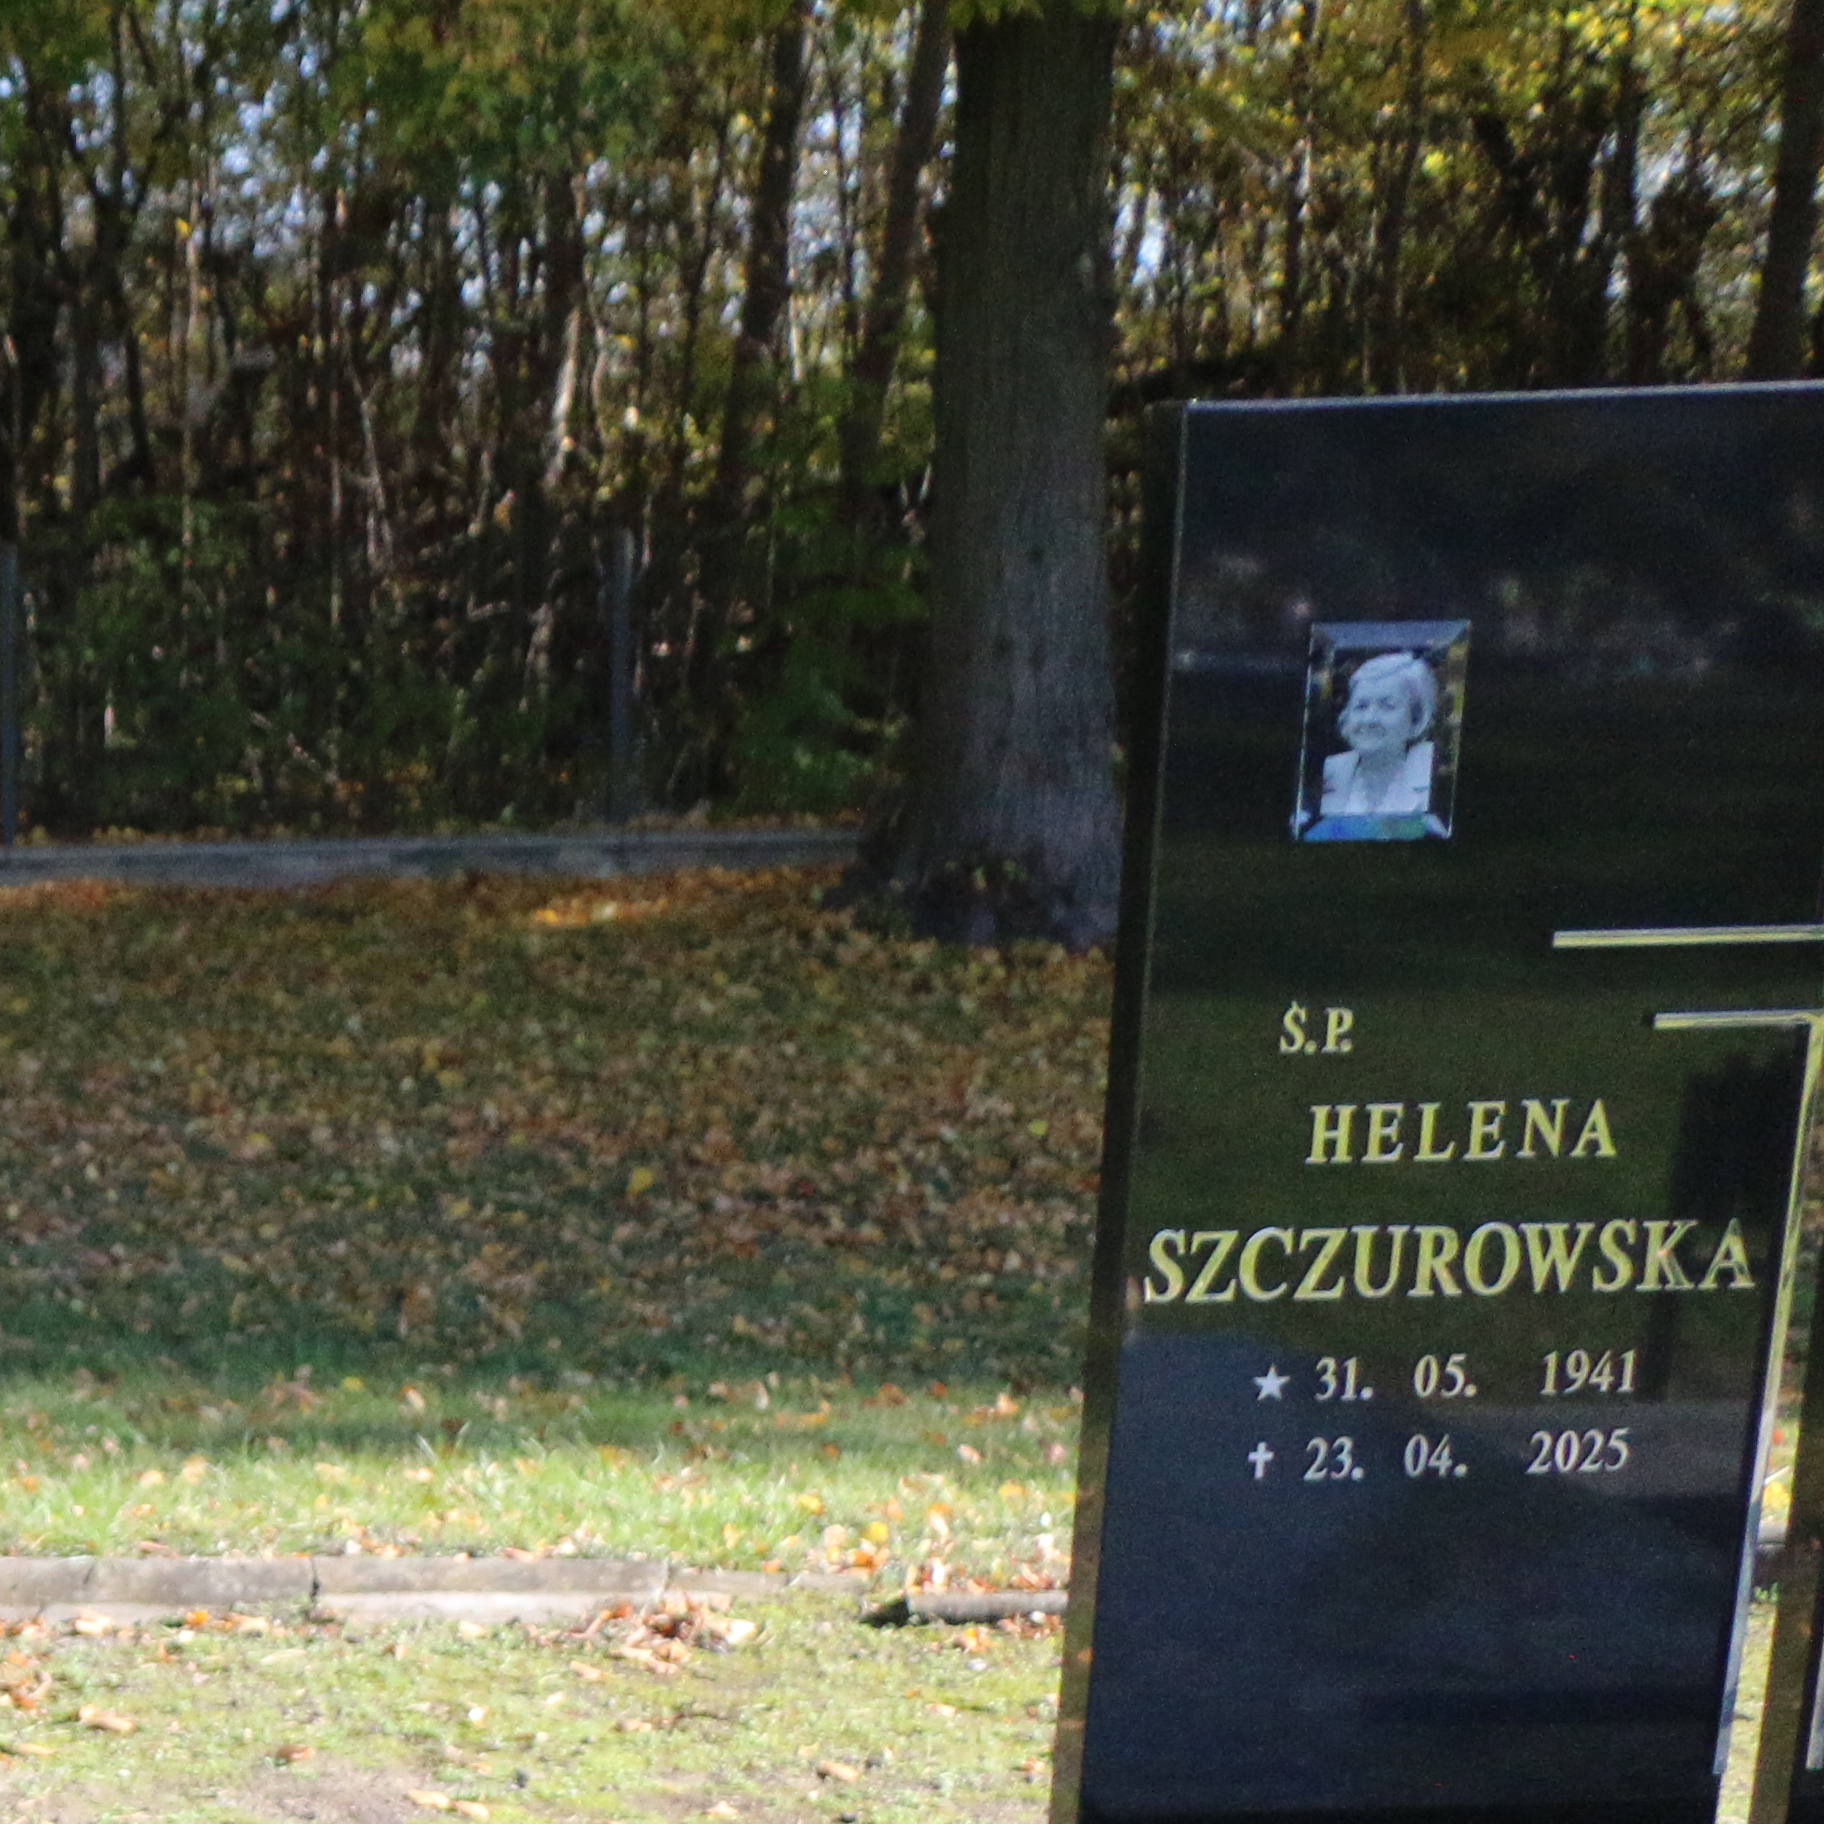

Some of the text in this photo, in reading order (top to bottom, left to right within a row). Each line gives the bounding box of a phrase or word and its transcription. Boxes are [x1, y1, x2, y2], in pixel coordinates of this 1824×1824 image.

[1304, 1098, 1618, 1164] HELENA
[1144, 1217, 1756, 1303] SZCZUROWSKA
[1314, 1348, 1638, 1401] 31. 05. 1941
[1303, 1427, 1631, 1482] 23. 04. 2025
